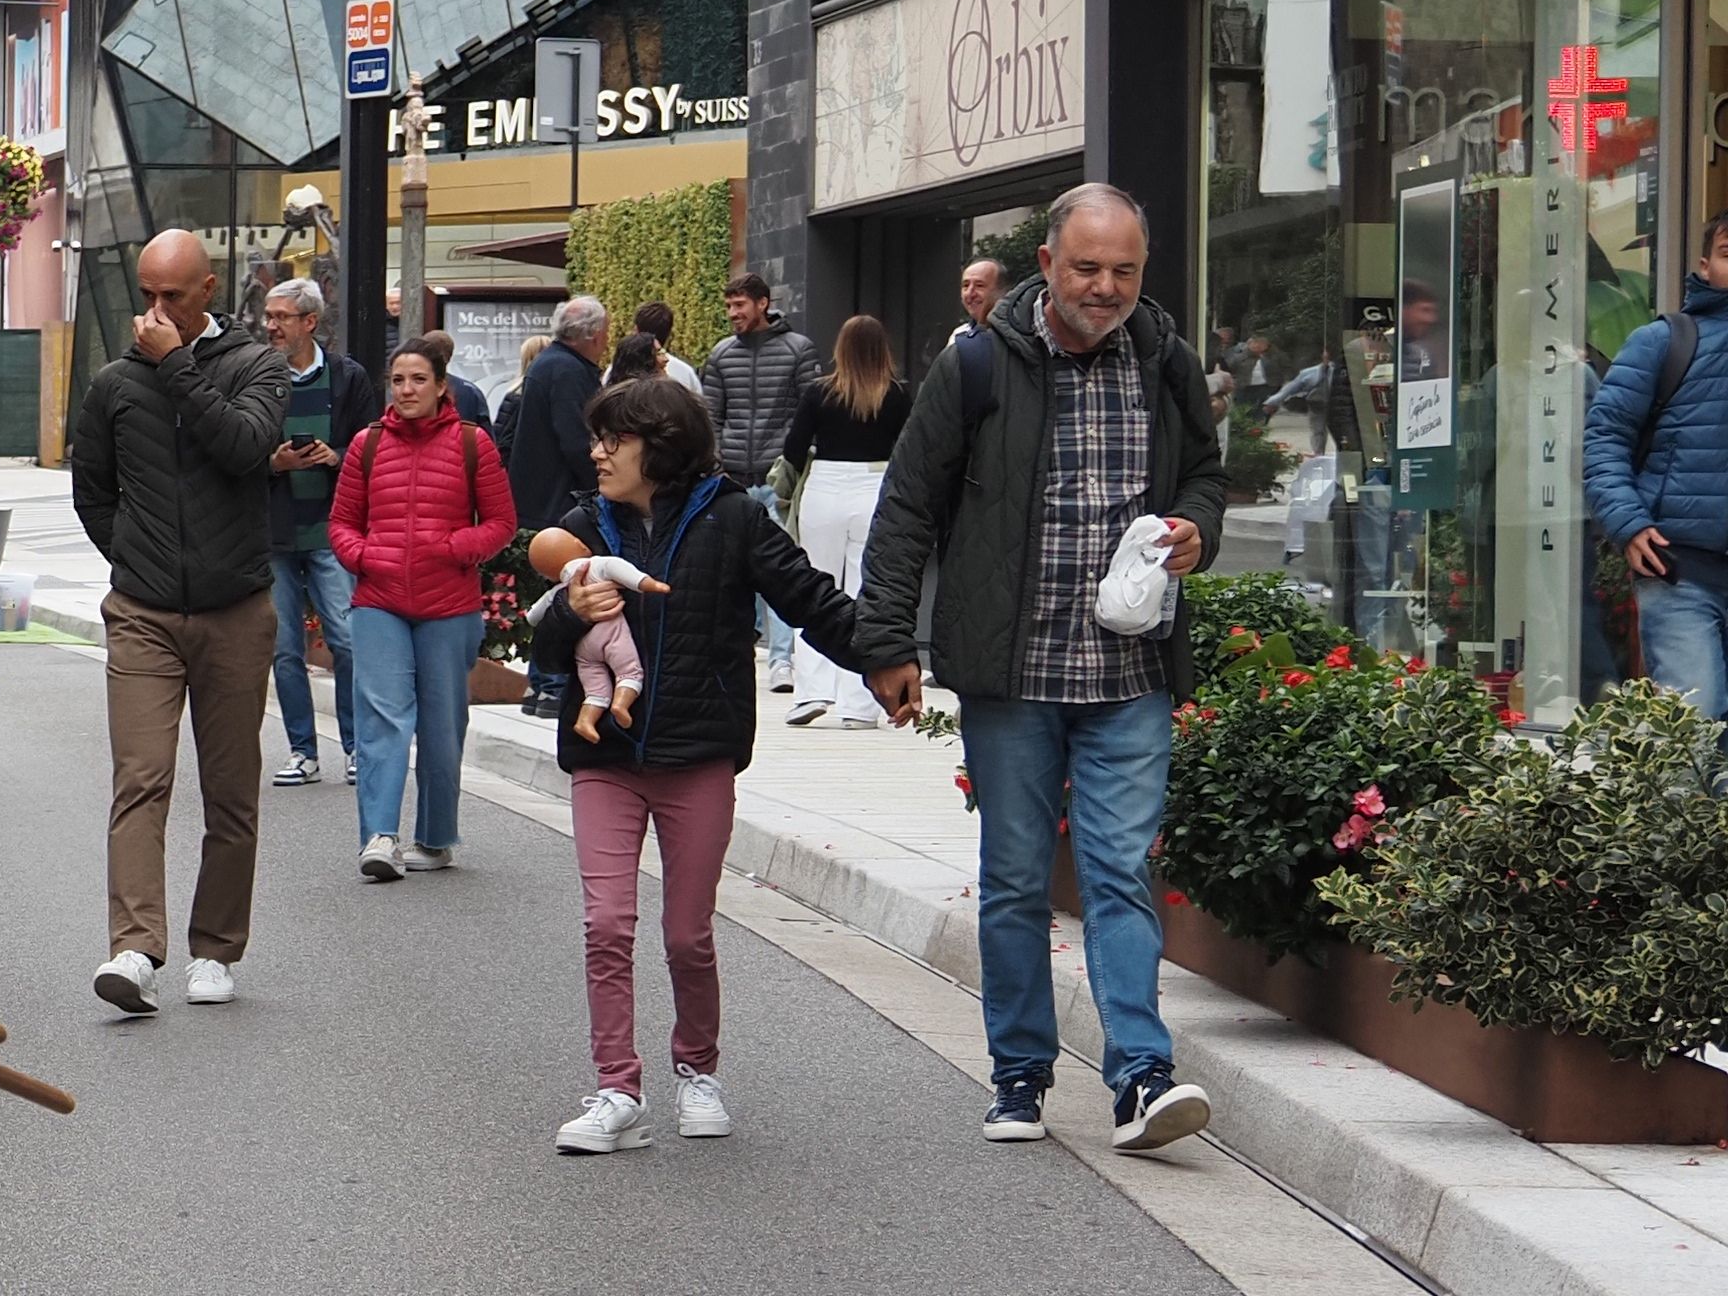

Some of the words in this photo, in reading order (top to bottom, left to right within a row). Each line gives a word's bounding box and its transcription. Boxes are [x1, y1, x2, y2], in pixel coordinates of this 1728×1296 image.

[675, 97, 692, 117] by
[458, 311, 491, 326] Mes
[493, 310, 517, 326] del
